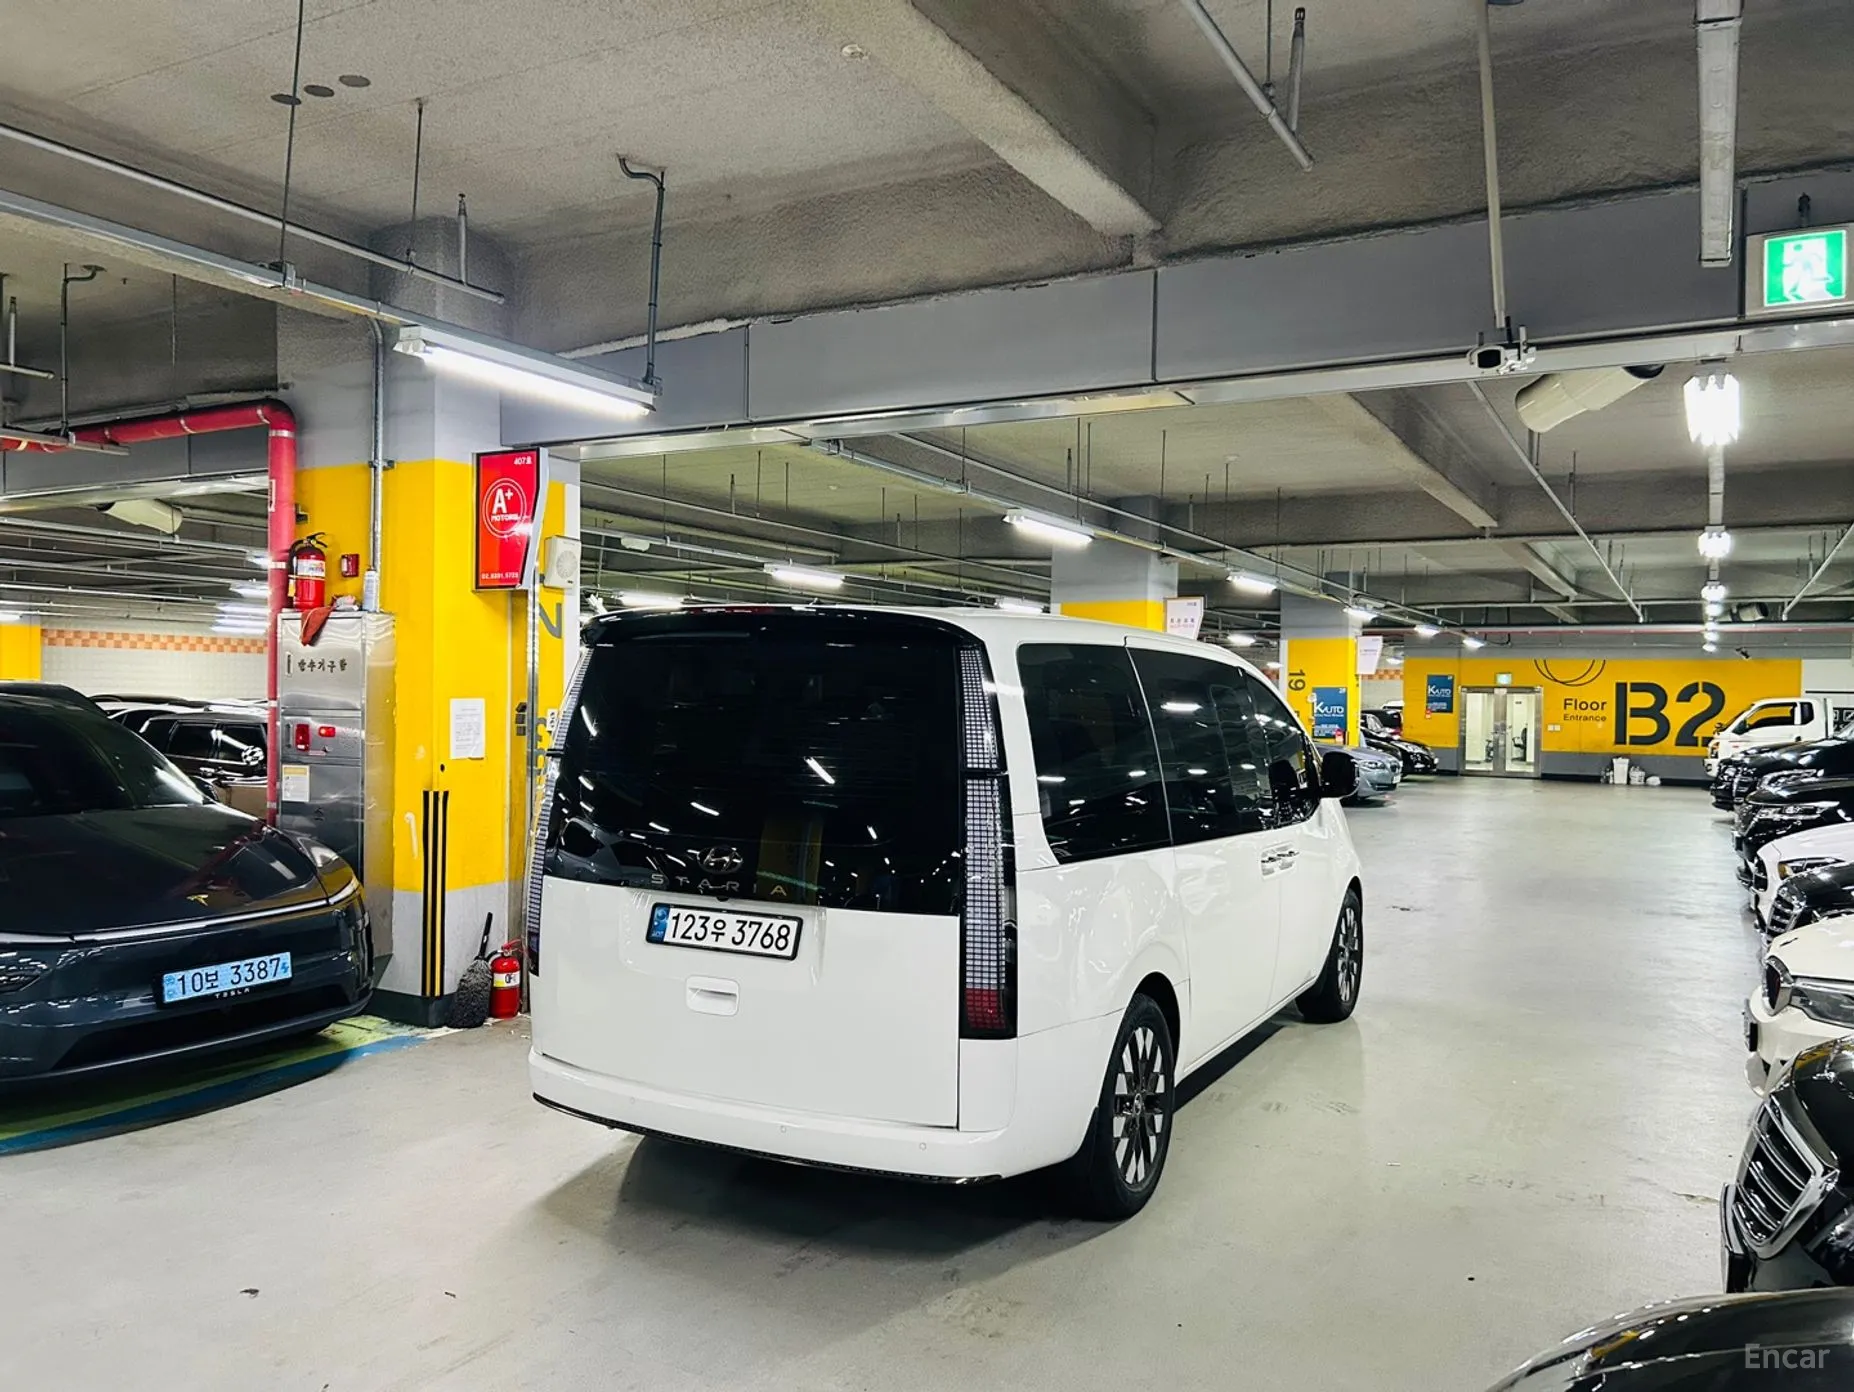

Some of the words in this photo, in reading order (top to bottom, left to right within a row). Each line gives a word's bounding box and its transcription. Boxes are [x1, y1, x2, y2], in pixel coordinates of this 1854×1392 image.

[1288, 669, 1306, 691] 19
[1563, 698, 1607, 711] Floor
[1614, 681, 1725, 747] B2
[1563, 713, 1607, 722] Entrance
[651, 874, 787, 897] STARIA
[671, 912, 727, 943] 123우
[731, 919, 791, 951] 3768
[177, 970, 219, 995] 10보
[230, 957, 281, 985] 3387
[215, 987, 250, 999] TESLA
